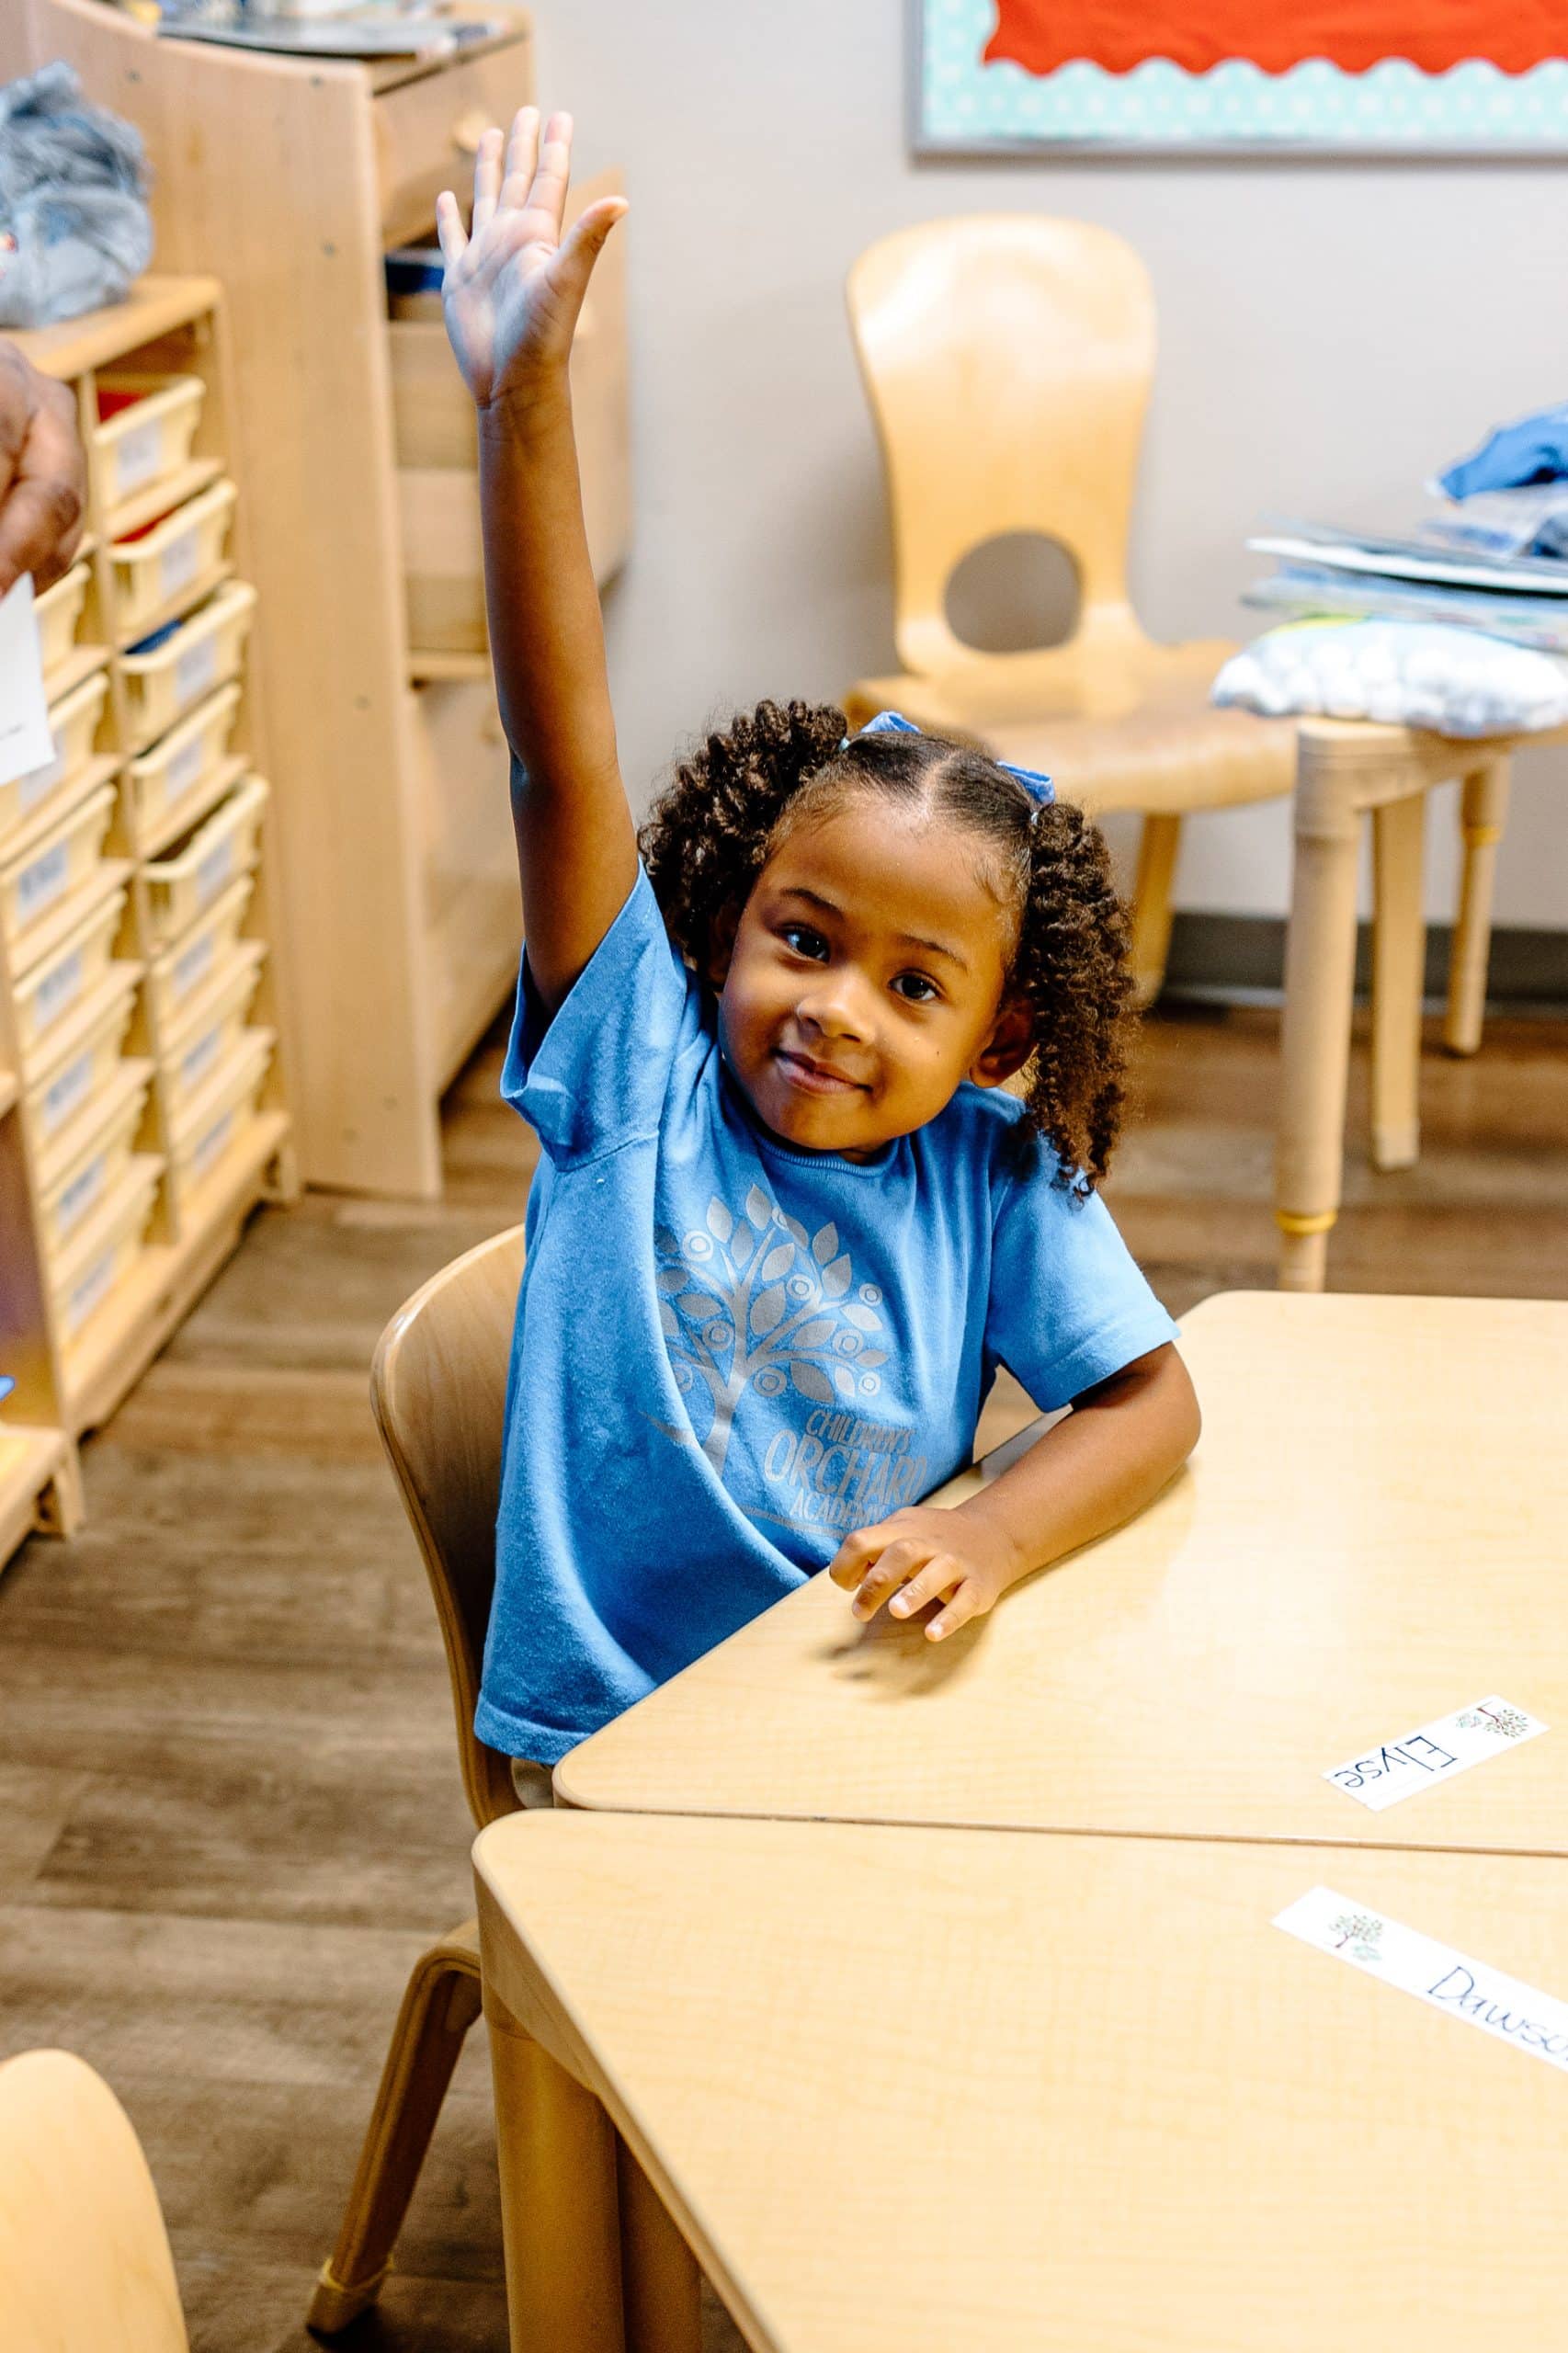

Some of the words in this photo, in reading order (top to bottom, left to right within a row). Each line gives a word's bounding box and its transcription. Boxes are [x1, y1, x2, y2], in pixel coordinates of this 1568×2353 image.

[805, 1409, 916, 1455] CHILDREN'S
[764, 1428, 927, 1505] ORCHARD
[1334, 1735, 1458, 1788] Elyse
[1427, 1965, 1568, 2062] Dawso
